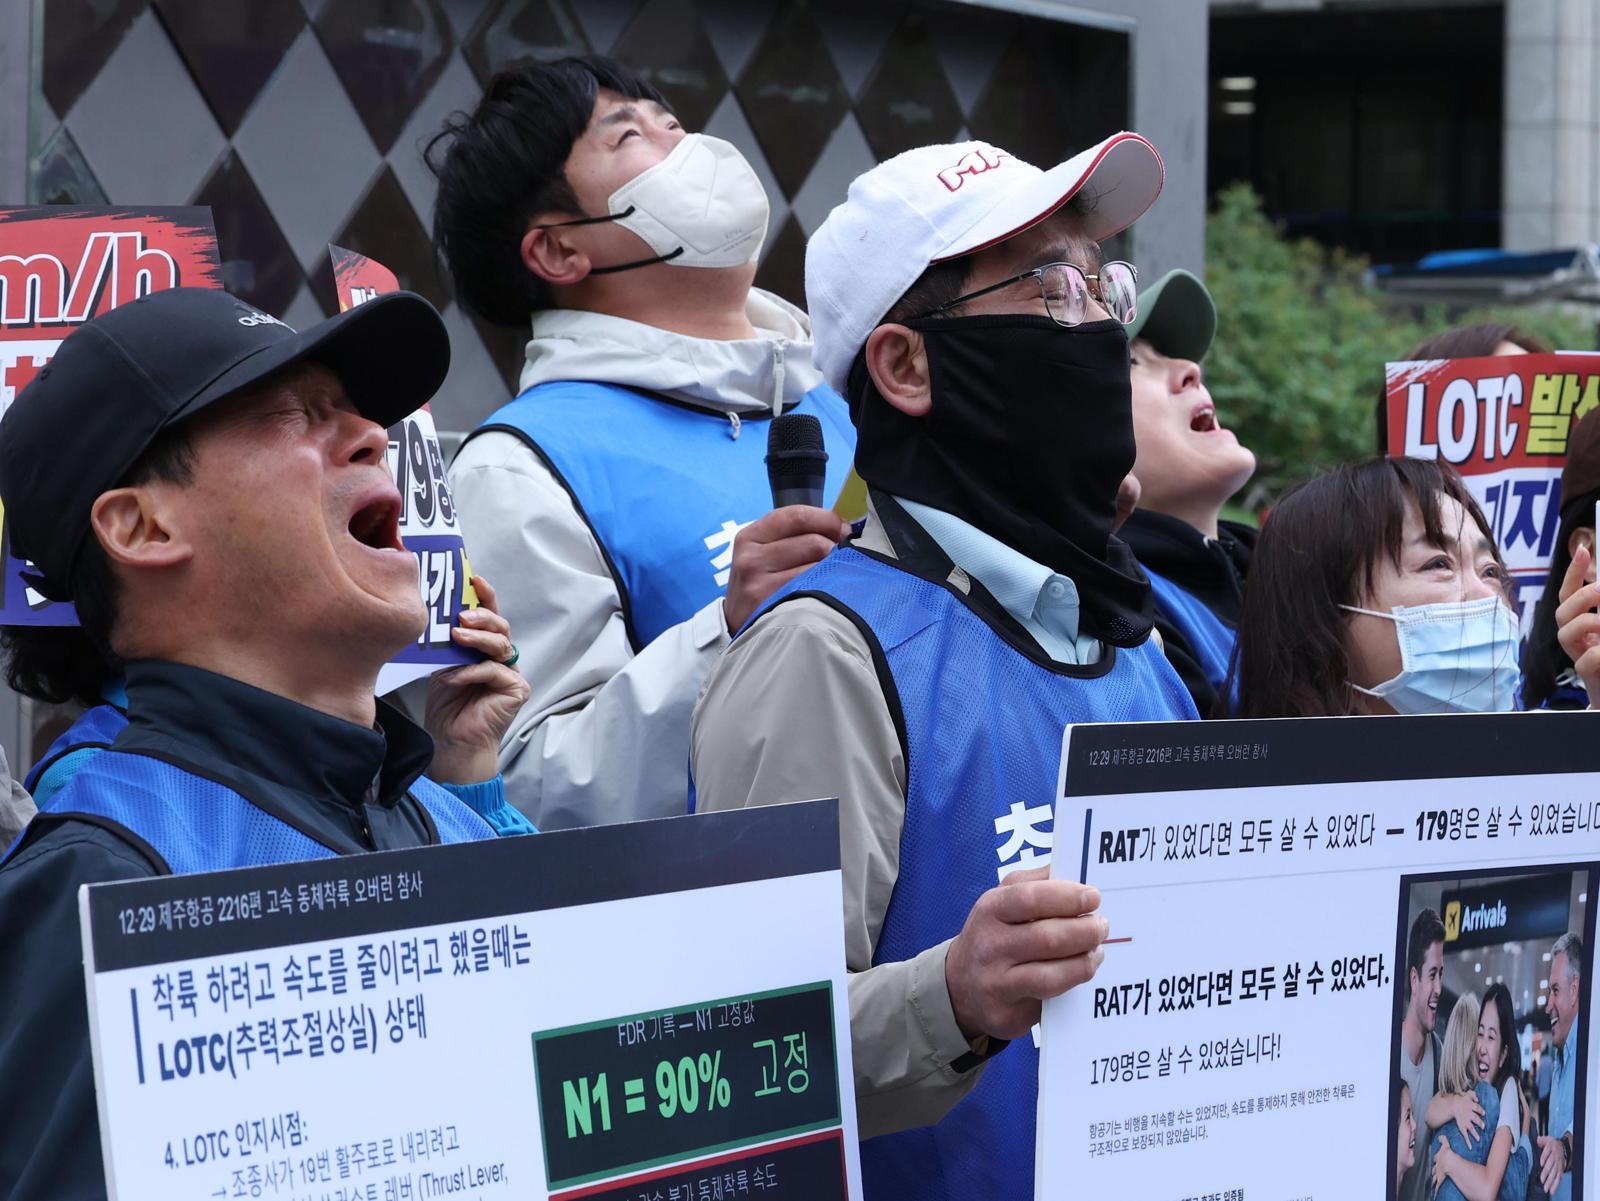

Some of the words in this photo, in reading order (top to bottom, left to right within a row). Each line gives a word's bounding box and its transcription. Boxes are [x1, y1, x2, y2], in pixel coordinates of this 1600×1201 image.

[1404, 373, 1523, 464] LOTC
[1112, 748, 1144, 765] 제주항공
[1145, 747, 1172, 764] 2216편
[1174, 746, 1191, 762] 고속
[1192, 745, 1225, 762] 동체착륙
[1226, 744, 1250, 761] 오버런
[1252, 743, 1268, 760] 참사
[1099, 826, 1156, 864] RAT가
[1164, 821, 1232, 861] 있었다면
[1239, 819, 1273, 854] 모두
[1280, 817, 1297, 851] 살
[1303, 816, 1318, 850] 수
[1326, 812, 1376, 849] 있었다
[1416, 808, 1480, 841] 179명은
[1487, 806, 1502, 838] 살
[1508, 804, 1523, 837] 수
[159, 896, 213, 931] 제주항공
[218, 890, 261, 922] 2216편
[266, 888, 293, 915] 고속
[298, 879, 350, 913] 동체착륙
[355, 875, 392, 903] 오버런
[397, 870, 423, 898] 참사
[1461, 898, 1508, 933] Arrivals
[152, 970, 198, 1022] 착륙
[206, 961, 275, 1013] 하려고
[283, 948, 348, 1001] 속도를
[357, 937, 443, 990] 줄이려고
[449, 925, 531, 976] 했을때는
[1093, 978, 1151, 1018] RAT가
[1158, 969, 1233, 1013] 있었다면
[1239, 966, 1276, 1001] 모두
[1283, 962, 1301, 998] 살
[1307, 961, 1324, 995] 수
[1330, 953, 1390, 993] 있었다.
[158, 1003, 378, 1082] LOTC(추력조절상실)
[384, 993, 427, 1043] 상태
[618, 1020, 647, 1047] FDR
[717, 999, 755, 1028] 고정값
[562, 1072, 612, 1139] N1
[624, 1077, 646, 1114] =
[655, 1049, 731, 1119] 90%
[752, 1031, 810, 1099] 고정
[1090, 1050, 1151, 1085] 179명은
[1157, 1046, 1172, 1077] 살
[1178, 1045, 1193, 1074] 수
[1199, 1032, 1281, 1071] 있었습니다!
[165, 1142, 179, 1169] 4.
[183, 1130, 230, 1165] LOTC
[235, 1111, 308, 1156] 인지시점:
[1089, 1120, 1122, 1139] 항공기는
[1124, 1115, 1148, 1133] 비행을
[1151, 1110, 1175, 1128] 지속할
[1177, 1108, 1193, 1124] 수는
[1195, 1102, 1229, 1122] 있었지만,
[1231, 1098, 1255, 1116] 속도를
[1257, 1094, 1288, 1113] 통제하지
[1290, 1091, 1306, 1108] 못해
[1307, 1087, 1331, 1105] 안전한
[1332, 1083, 1355, 1101] 착륙은
[232, 1157, 294, 1198] 조종사가
[300, 1149, 331, 1184] 19번
[336, 1138, 397, 1179] 활주로로
[400, 1125, 460, 1163] 내리려고
[1089, 1138, 1129, 1159] 구조적으로
[1131, 1131, 1164, 1150] 보장되지
[1166, 1124, 1208, 1146] 않았습니다.
[419, 1167, 466, 1201] (Thrust
[468, 1163, 508, 1188] Lever,
[699, 1169, 749, 1201] 동체착륙
[753, 1163, 778, 1191] 속도
